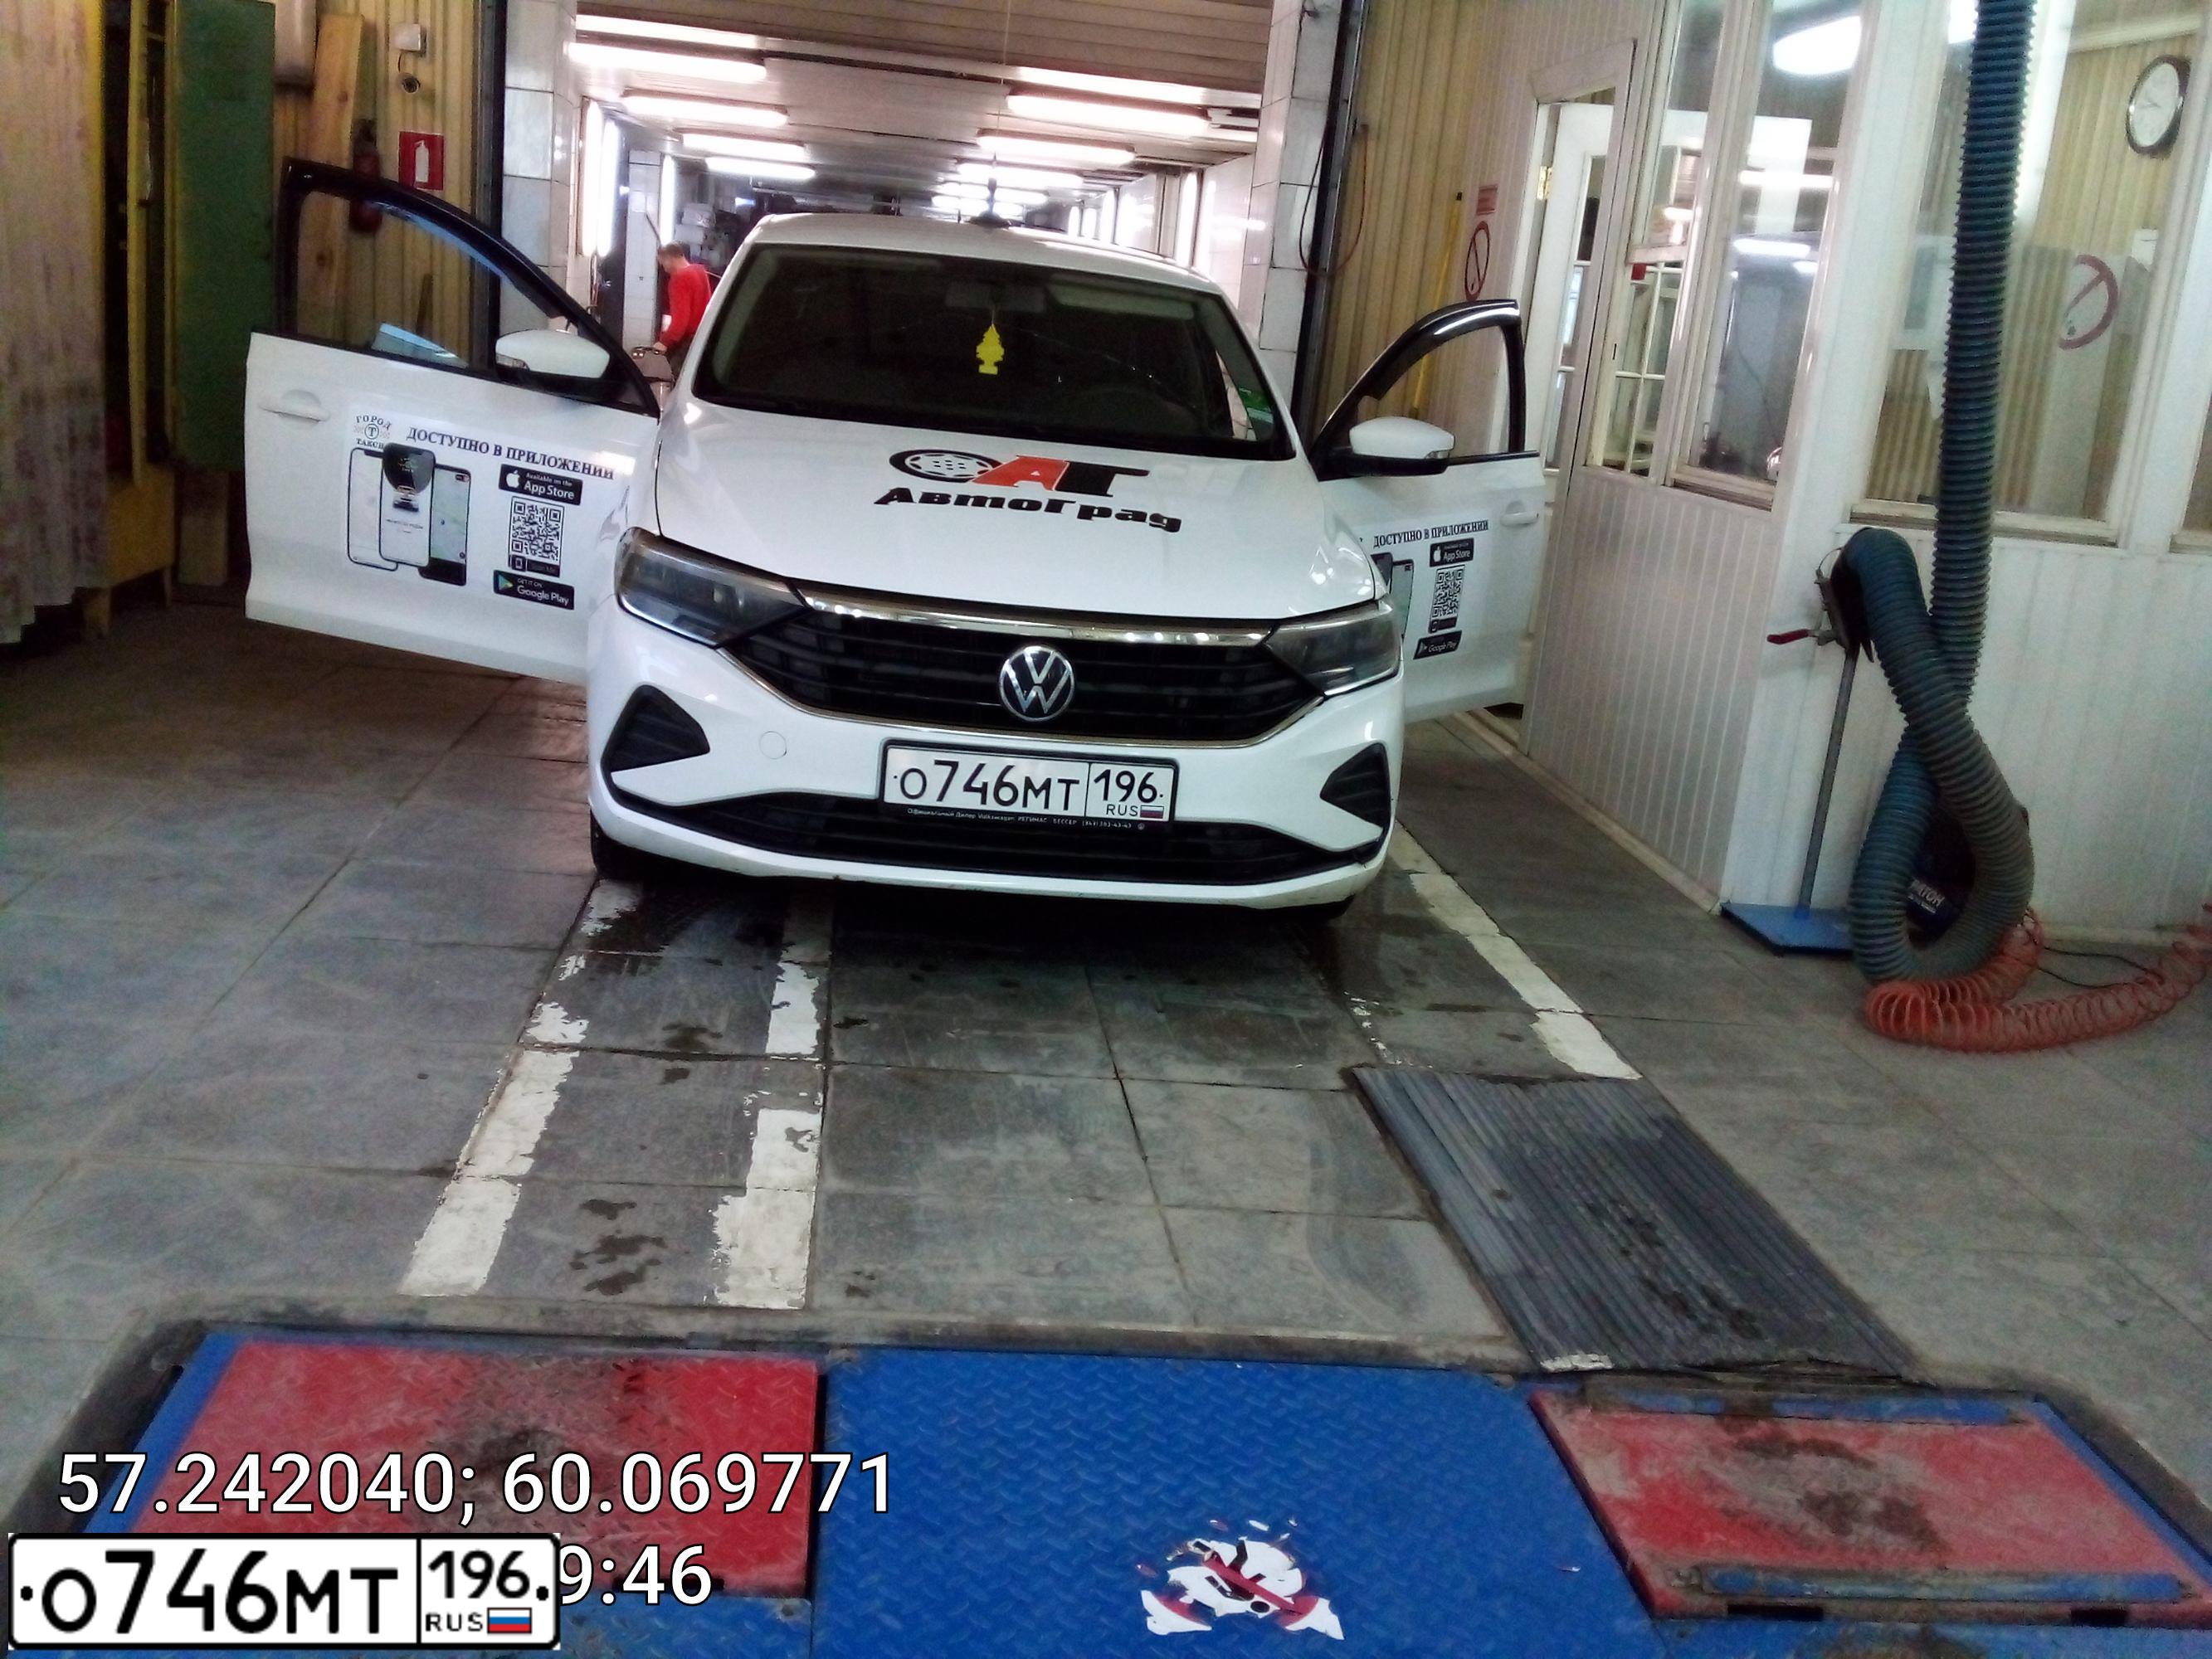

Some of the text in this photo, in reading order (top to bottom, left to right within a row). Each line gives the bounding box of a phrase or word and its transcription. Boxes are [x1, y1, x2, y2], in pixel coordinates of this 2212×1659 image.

[356, 415, 392, 431] ГОРОД
[407, 427, 614, 479] ДОСТУПНО В ПРИЛОЖЕНИИ
[525, 472, 553, 482] Available
[524, 480, 575, 500] App Store
[1373, 529, 1422, 548] ДОСТУПНО
[1431, 519, 1488, 538] ПРИЛОЖЕНИИ
[517, 585, 570, 606] Google Play
[1093, 768, 1158, 804] 196
[1105, 804, 1138, 818] RUS
